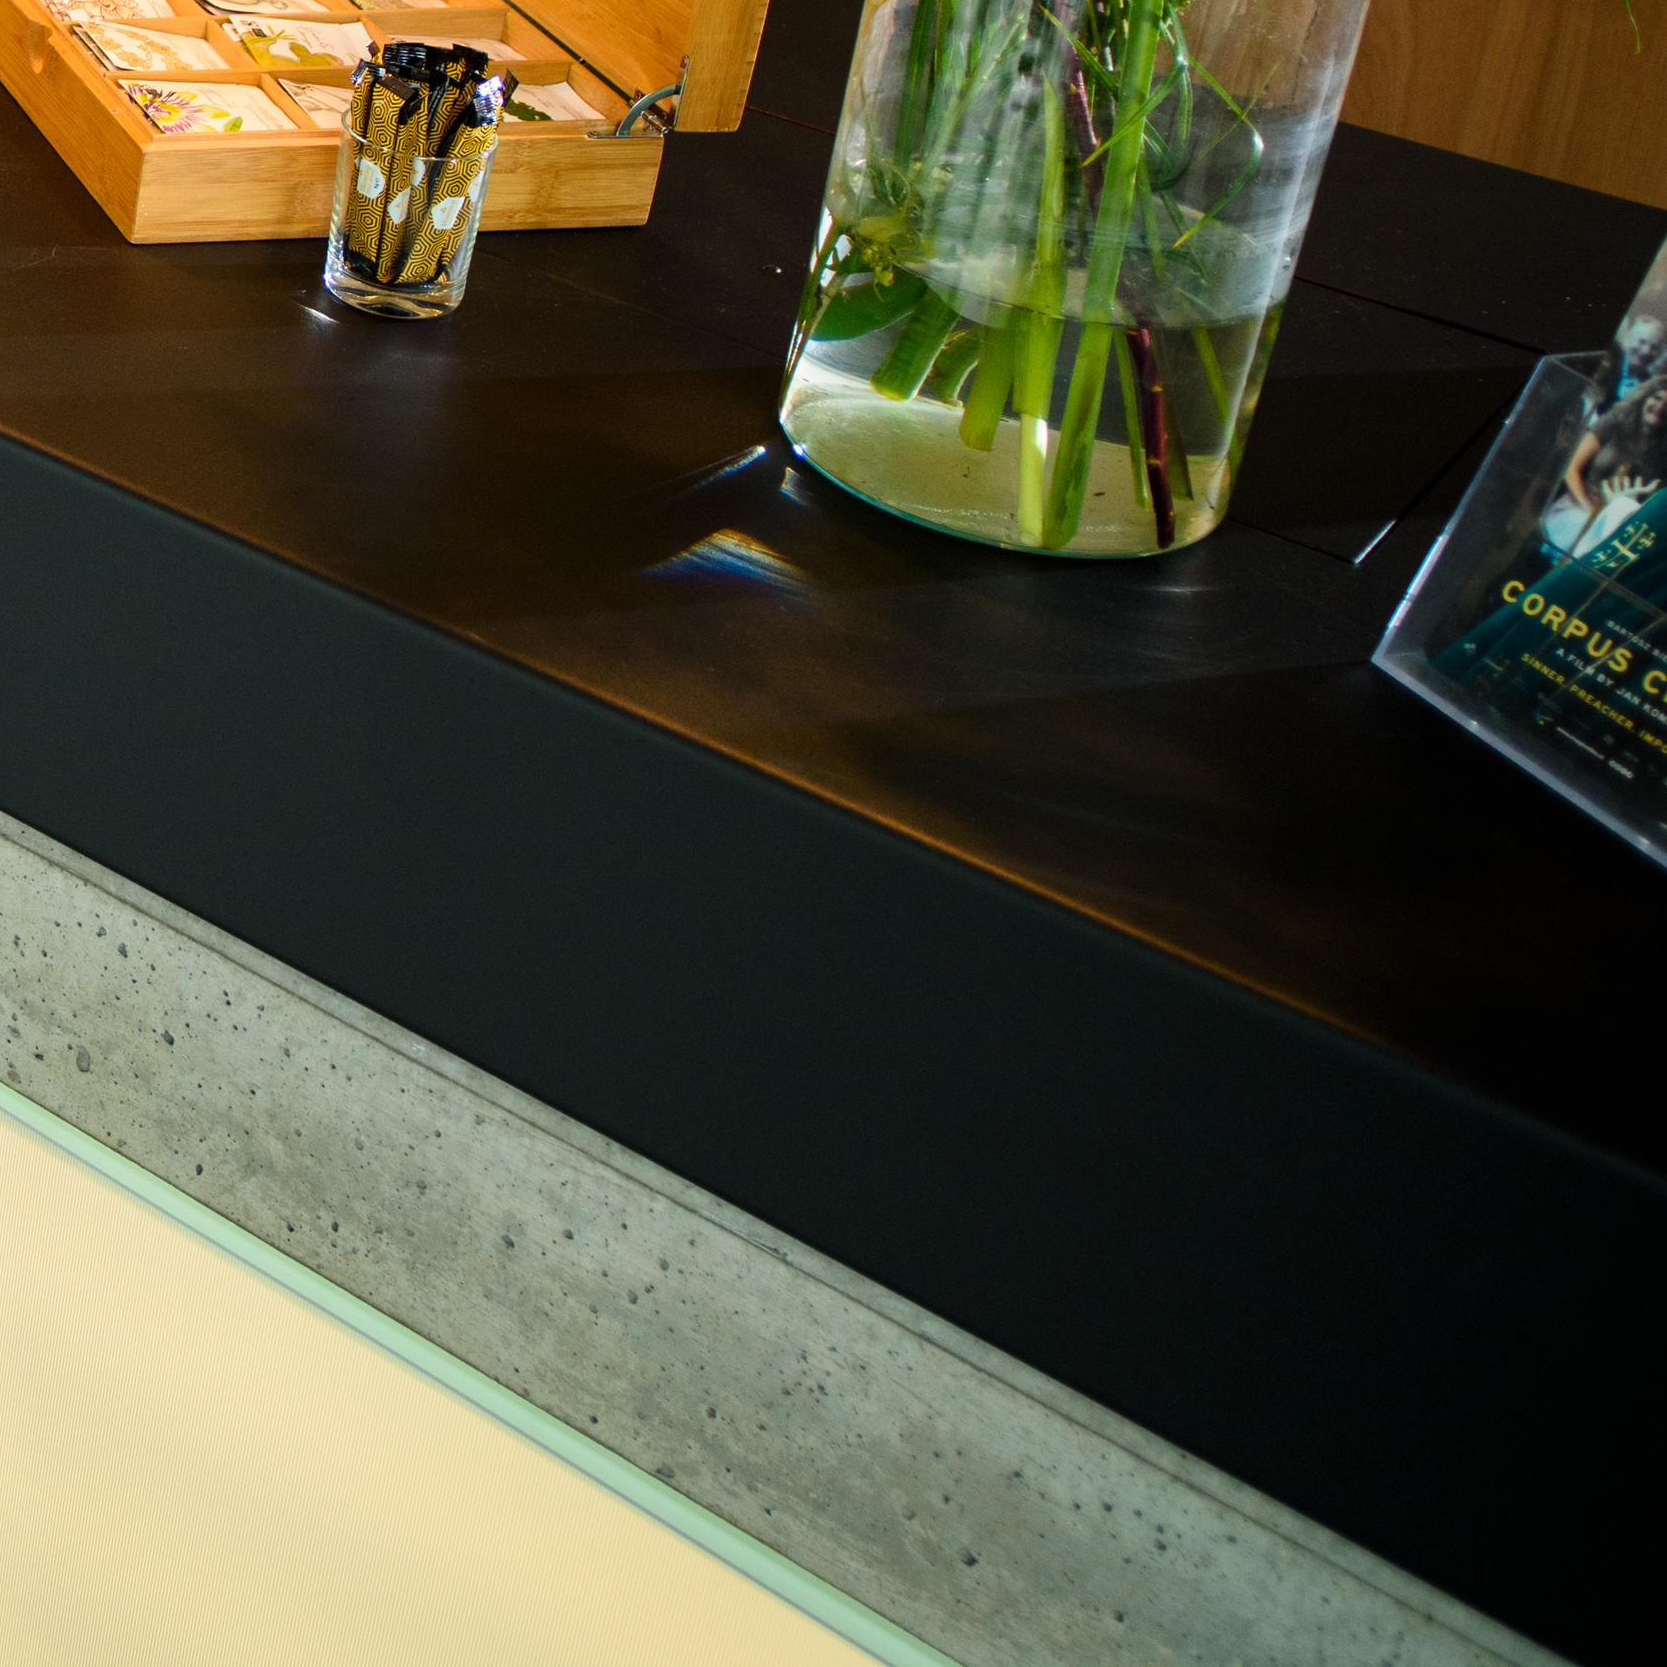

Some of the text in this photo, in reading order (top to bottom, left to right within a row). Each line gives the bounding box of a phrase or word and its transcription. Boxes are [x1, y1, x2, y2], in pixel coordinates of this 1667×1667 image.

[1502, 580, 1633, 673] CORPUS
[1607, 619, 1652, 652] BARTOSZ
[1556, 647, 1566, 658] A
[1567, 653, 1596, 676] FILM
[1597, 673, 1614, 687] BY
[1616, 686, 1642, 706] JAN
